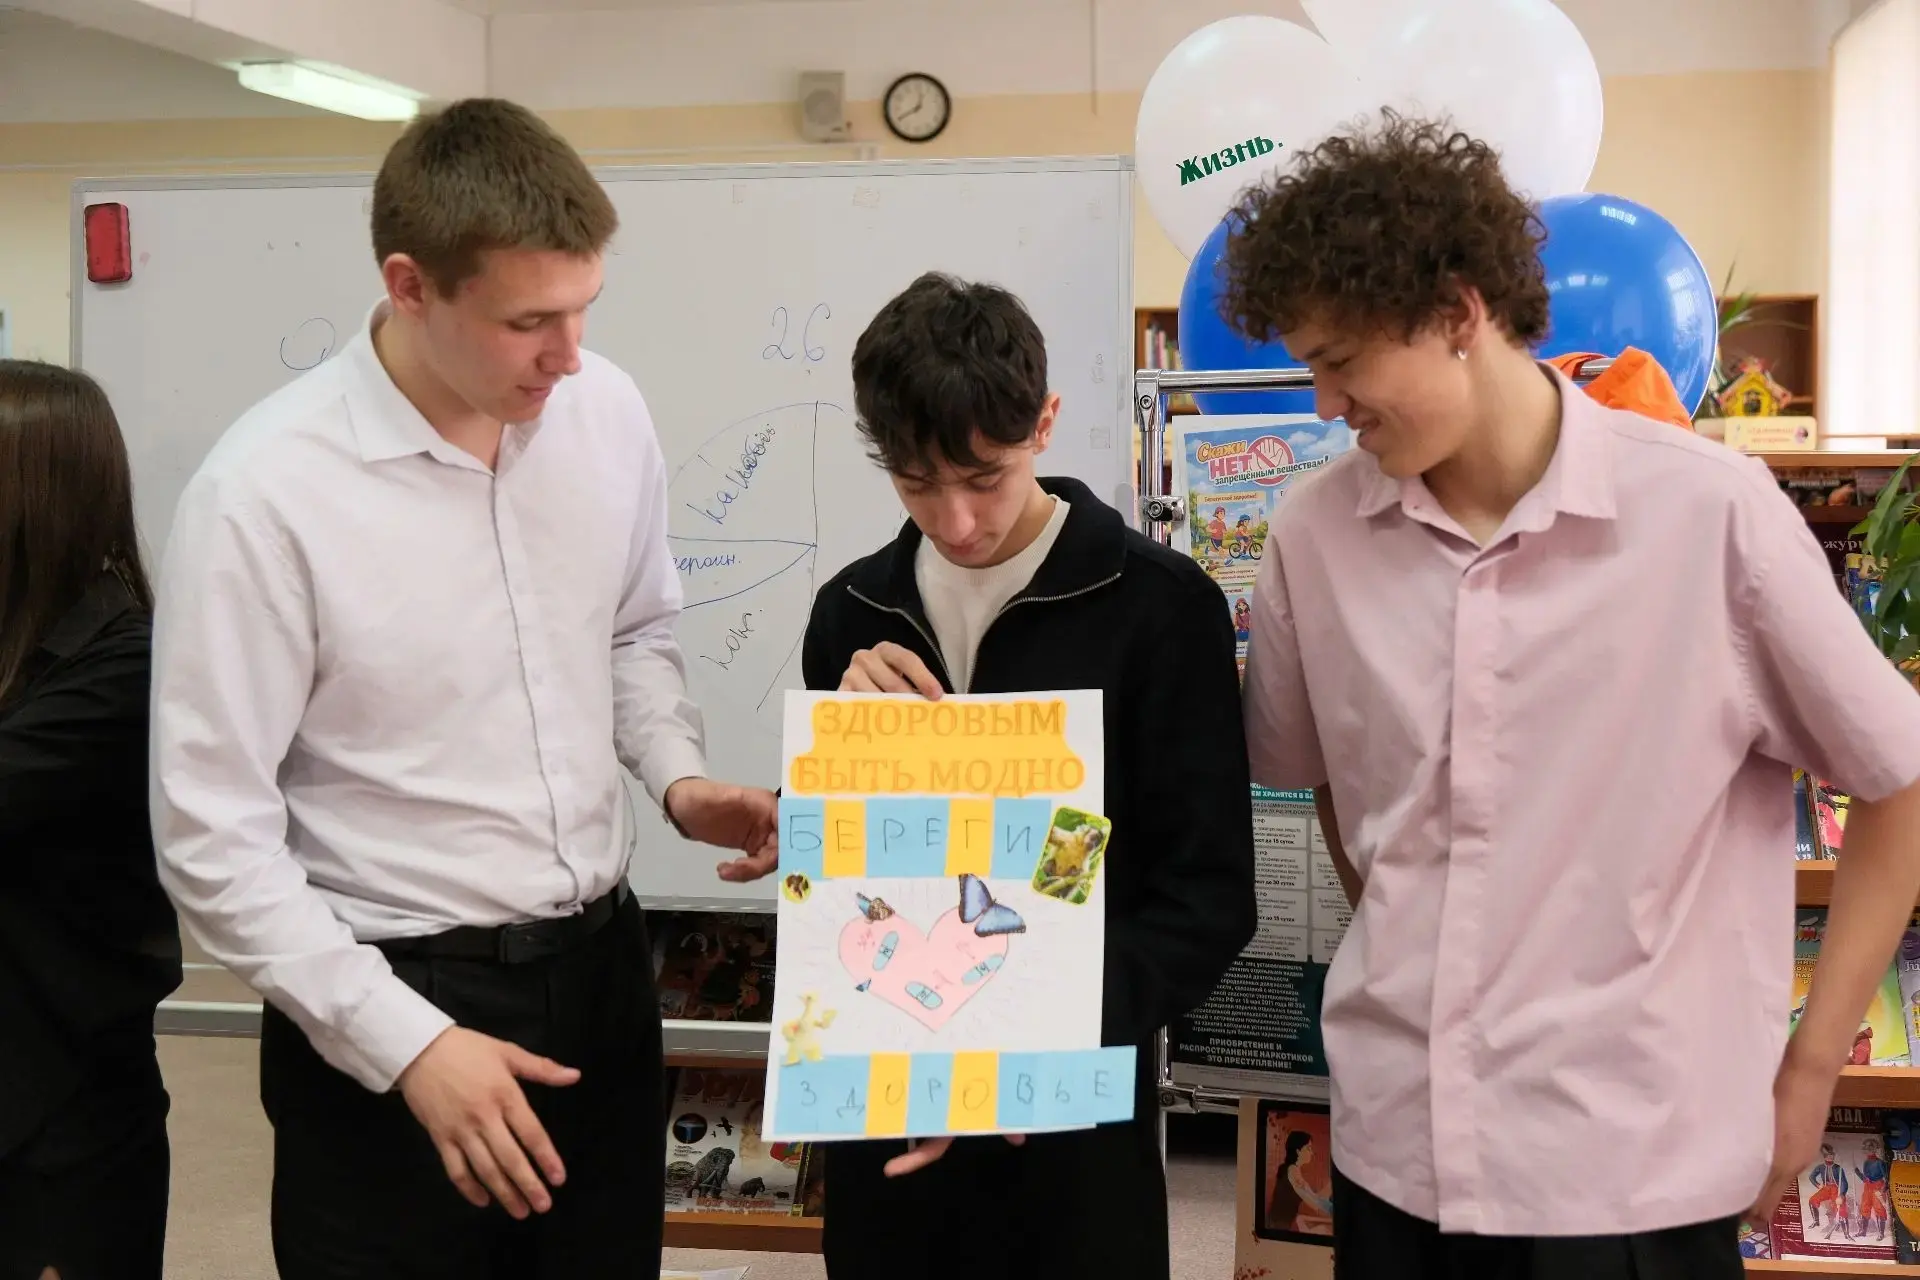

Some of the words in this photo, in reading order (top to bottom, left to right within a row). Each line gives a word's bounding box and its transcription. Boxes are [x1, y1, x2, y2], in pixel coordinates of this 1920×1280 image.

[1198, 441, 1246, 461] Скажи
[1210, 454, 1252, 479] НЕТ
[1215, 469, 1275, 485] запрещённым
[1276, 455, 1329, 475] веществам!
[818, 700, 1063, 744] ЗДОРОВЫМ
[796, 756, 916, 792] БЫТЬ
[929, 756, 1085, 797] МОДНО
[1262, 791, 1298, 799] ХРАНЯТСЯ
[788, 814, 1032, 854] БЕРЕГИ
[1179, 1043, 1259, 1058] РАСПРОСТРАНЕНИЕ
[1259, 1051, 1314, 1063] НАРКОТИКОВ
[1209, 1037, 1274, 1051] ПРИОБРЕТЕНИЕ
[1276, 1041, 1282, 1050] И
[1207, 1055, 1222, 1063] ЭТО
[1224, 1056, 1292, 1069] ПРЕСТУПЛЕНИЕ!
[800, 1069, 1113, 1119] ЗДОРОВЬЕ
